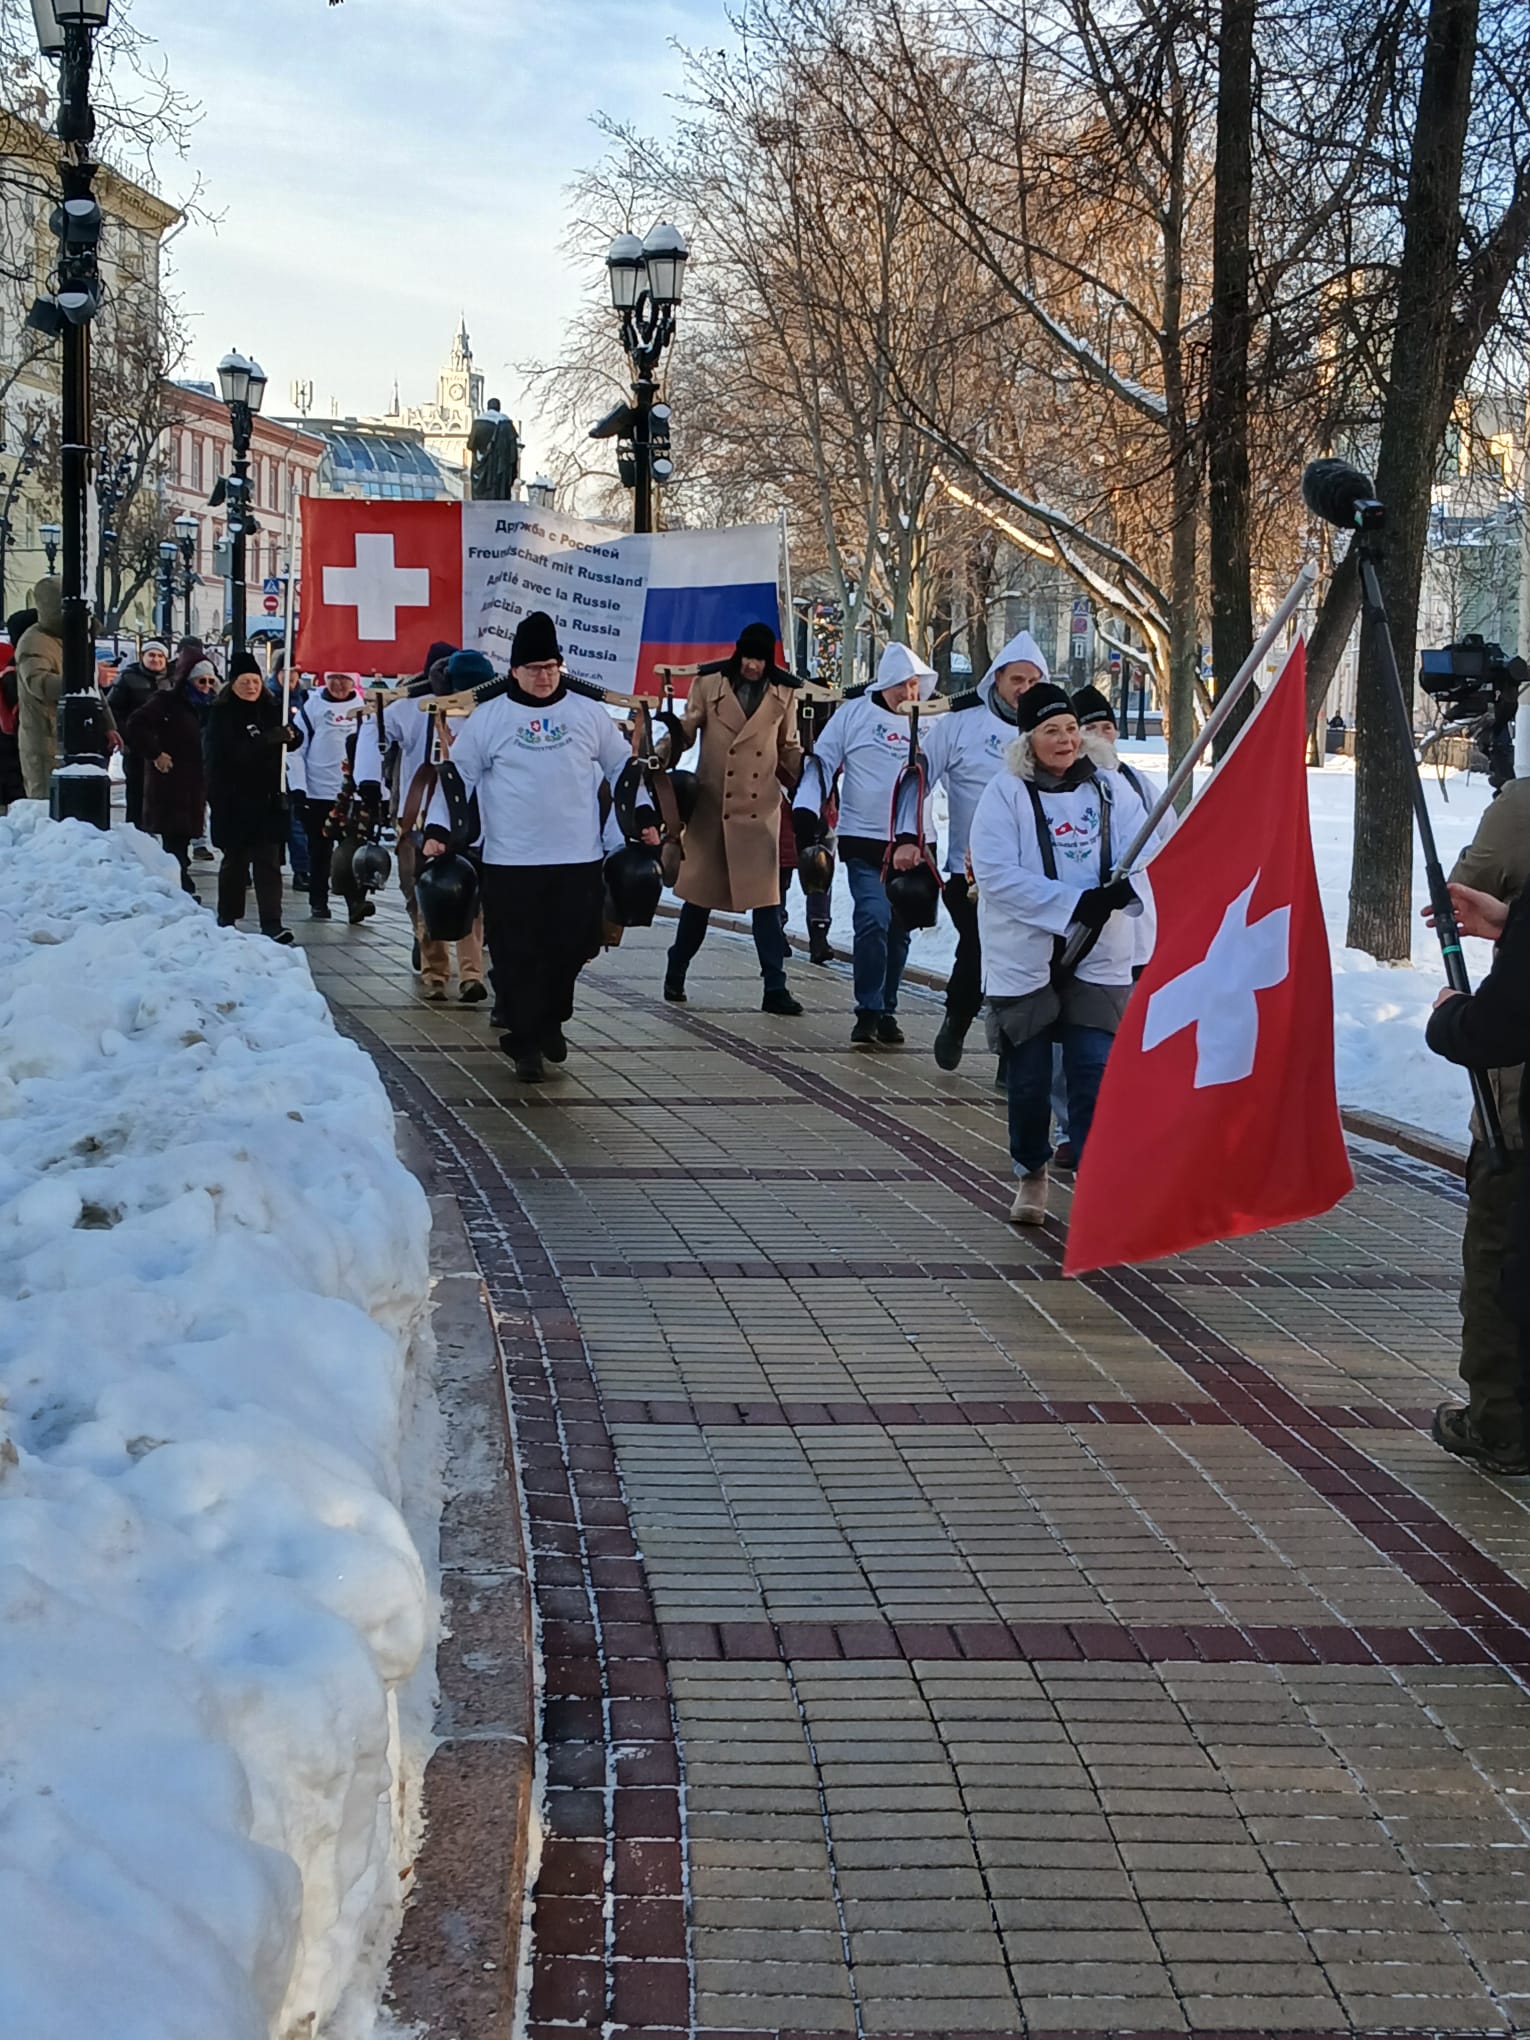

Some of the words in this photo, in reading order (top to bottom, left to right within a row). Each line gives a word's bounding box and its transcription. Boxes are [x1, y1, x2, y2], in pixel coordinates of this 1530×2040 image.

[548, 532, 557, 542] с
[559, 533, 619, 560] Россией
[551, 561, 574, 576] mit
[577, 566, 643, 587] Russland
[521, 579, 552, 596] avec
[555, 587, 568, 601] la
[572, 592, 621, 611] Russie
[554, 614, 567, 628] la
[572, 618, 621, 637] Russia
[568, 644, 617, 662] Russia
